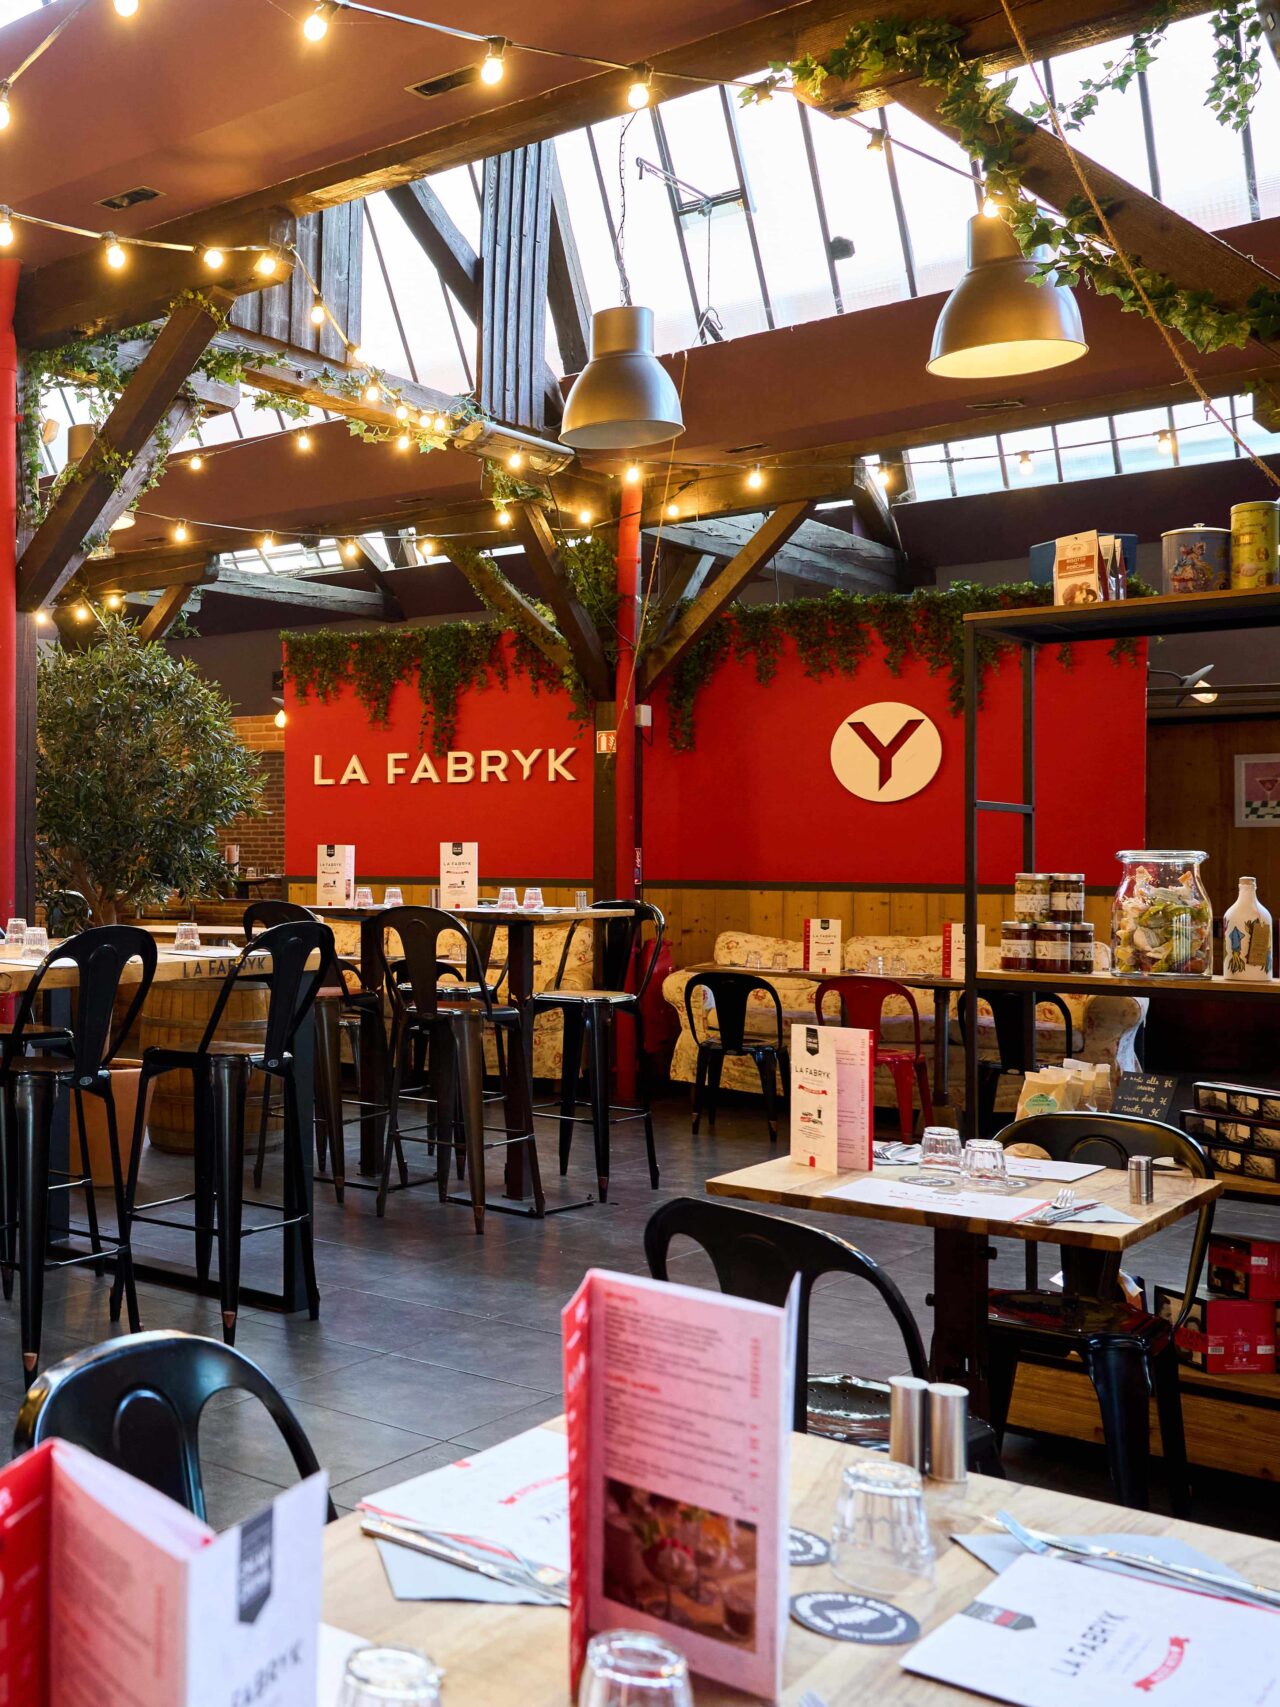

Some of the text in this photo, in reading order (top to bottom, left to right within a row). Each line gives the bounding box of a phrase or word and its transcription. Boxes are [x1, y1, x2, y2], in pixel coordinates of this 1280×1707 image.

[313, 747, 578, 786] LA FABRYK
[847, 718, 926, 792] Y
[183, 960, 203, 978] LA
[795, 1065, 831, 1079] LA FABRYK
[1066, 1609, 1130, 1658] FABRYK
